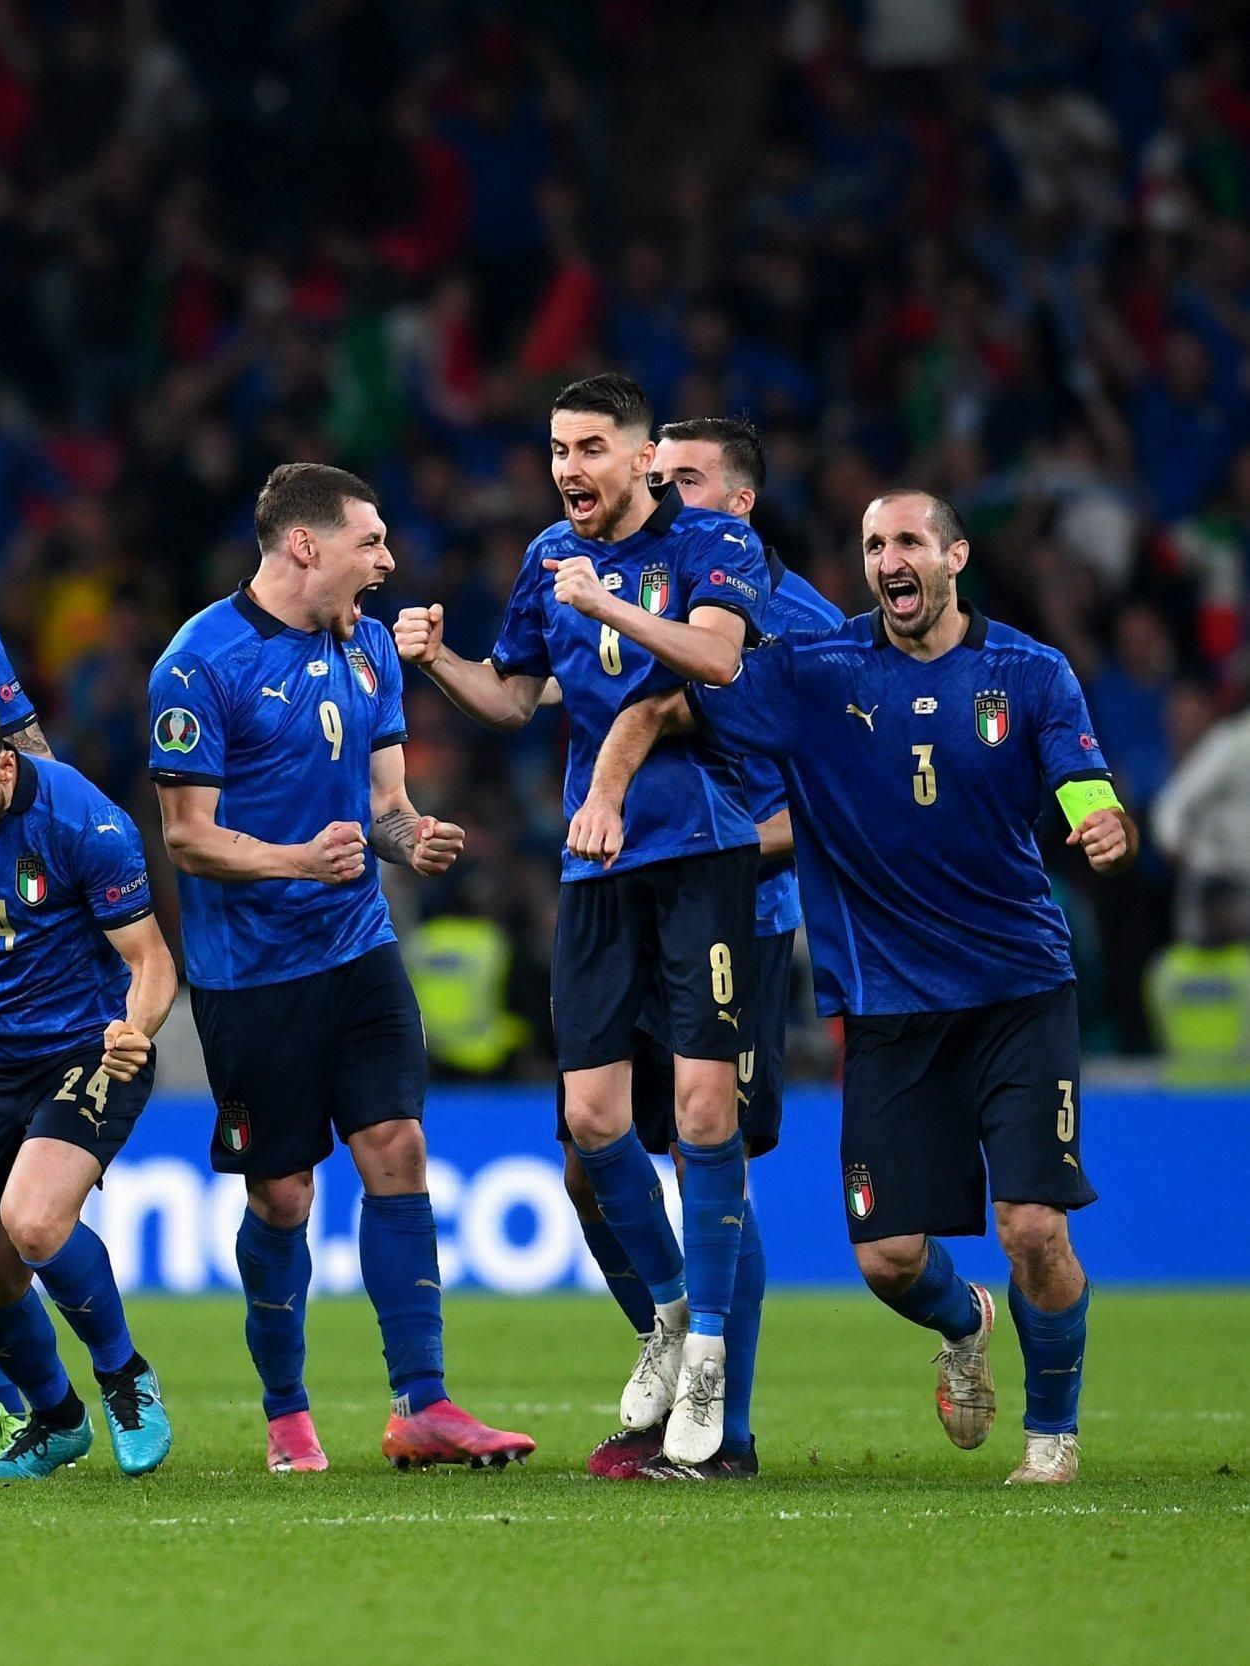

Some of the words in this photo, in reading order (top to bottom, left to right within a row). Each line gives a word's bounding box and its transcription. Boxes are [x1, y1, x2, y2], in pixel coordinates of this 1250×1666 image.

[644, 574, 667, 582] ITALIA
[726, 575, 757, 599] RESPECT
[977, 701, 1006, 710] ITALIA
[318, 700, 345, 761] 9
[911, 744, 937, 806] 3
[19, 861, 44, 870] ITALIA
[120, 871, 148, 895] RESPECT
[709, 942, 734, 1005] 8
[52, 1066, 111, 1114] 24
[1056, 1080, 1075, 1143] 3
[847, 1174, 868, 1185] ITALIA
